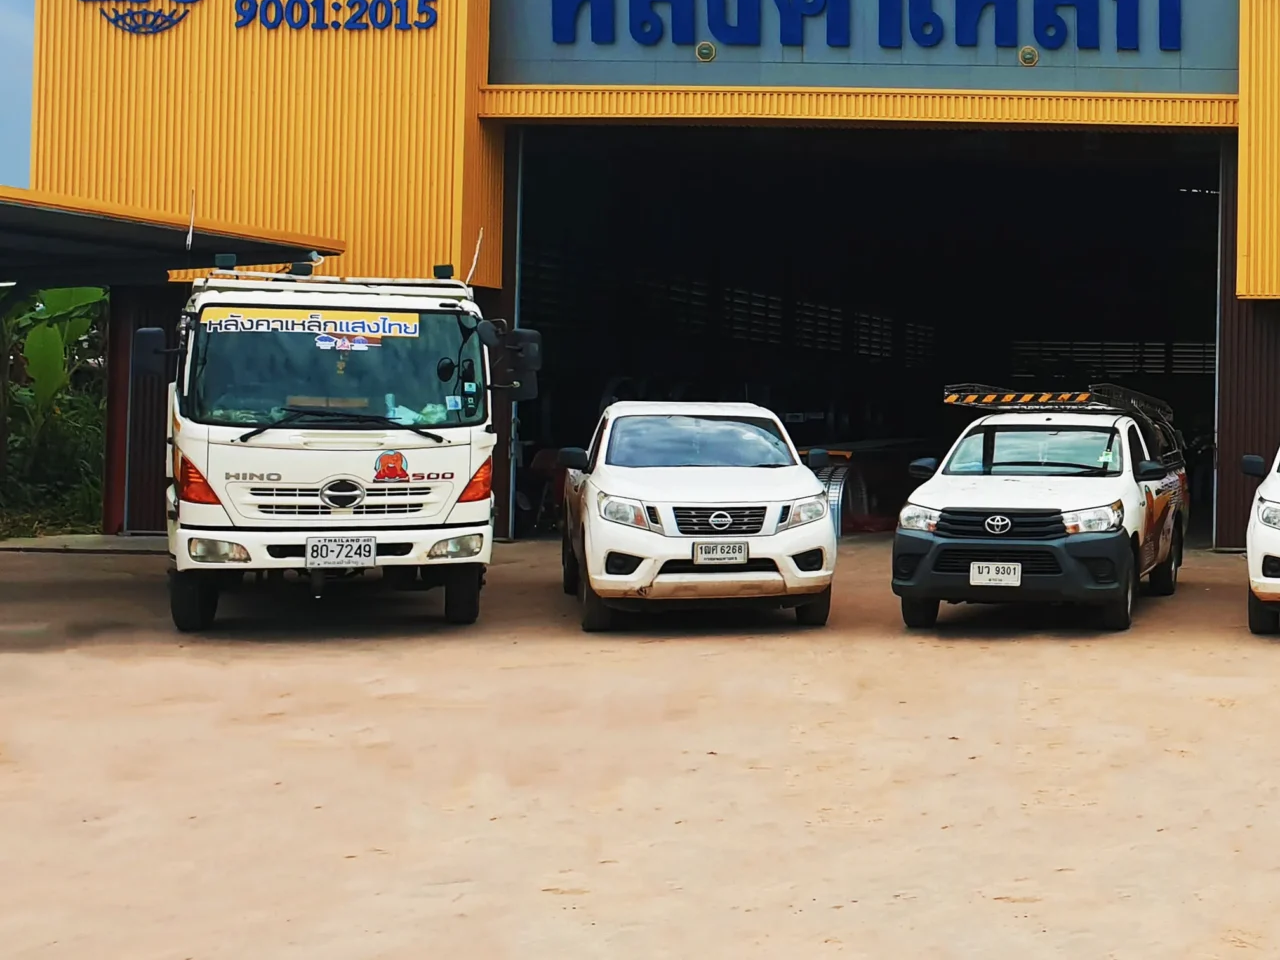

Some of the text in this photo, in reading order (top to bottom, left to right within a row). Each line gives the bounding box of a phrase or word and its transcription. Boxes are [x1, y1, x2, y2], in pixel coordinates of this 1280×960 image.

[207, 314, 419, 336] หลังคาเหล็กแสงไทย
[224, 472, 282, 482] HINO
[412, 472, 454, 480] 500
[310, 543, 372, 559] 80-7249
[720, 545, 743, 555] 6268
[995, 566, 1017, 576] 9301
